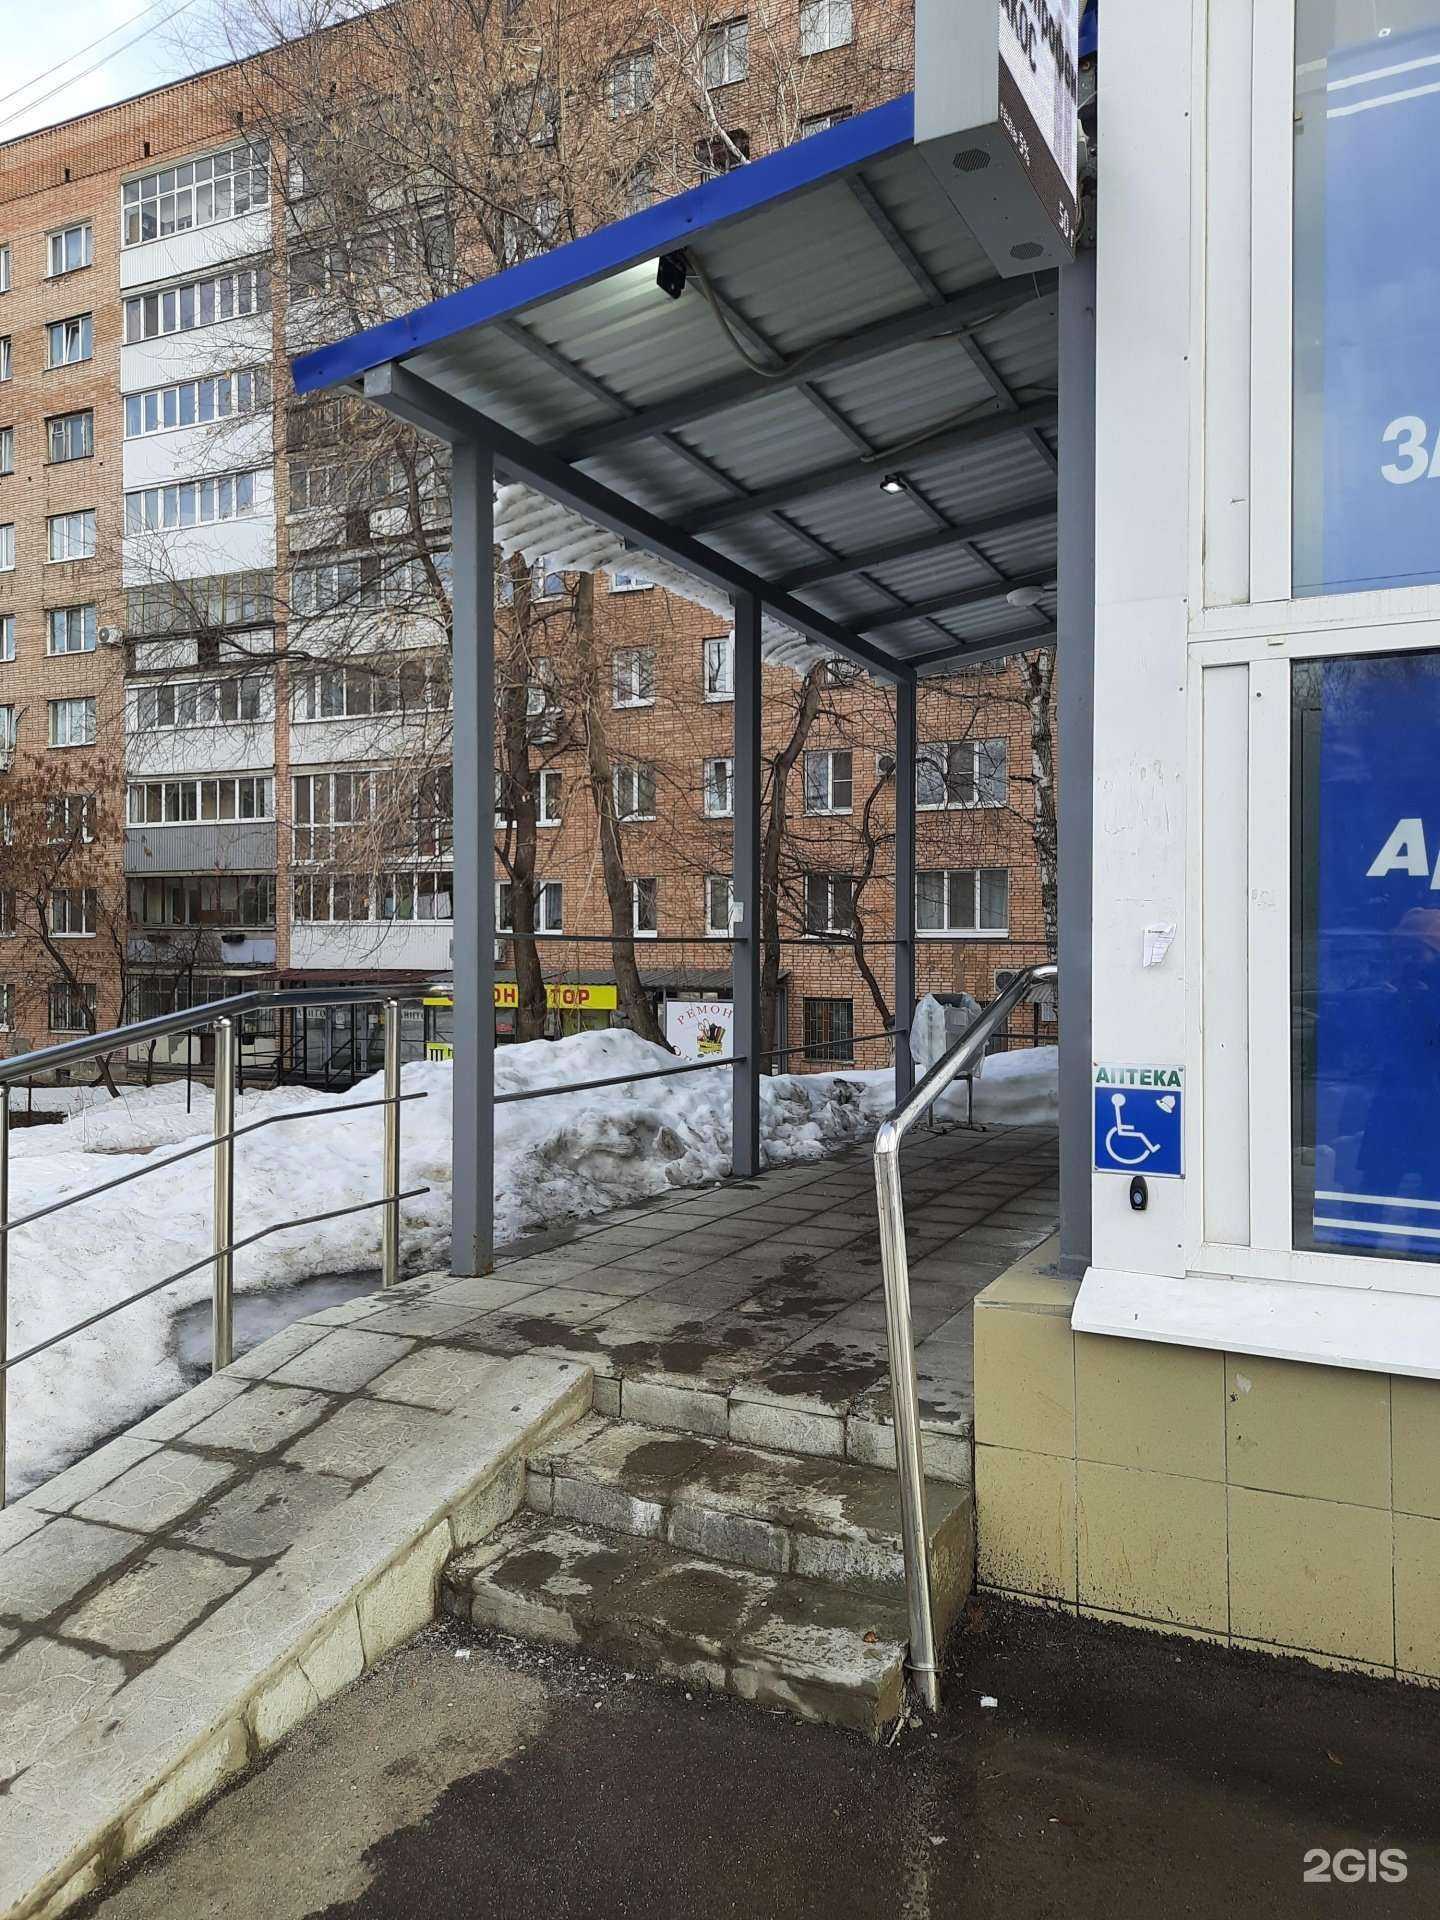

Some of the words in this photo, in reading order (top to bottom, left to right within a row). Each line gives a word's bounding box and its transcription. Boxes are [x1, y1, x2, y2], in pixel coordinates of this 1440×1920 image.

[1365, 818, 1440, 890] А
[676, 1005, 733, 1024] РЕМОН
[1096, 1067, 1182, 1088] АПТЕКА
